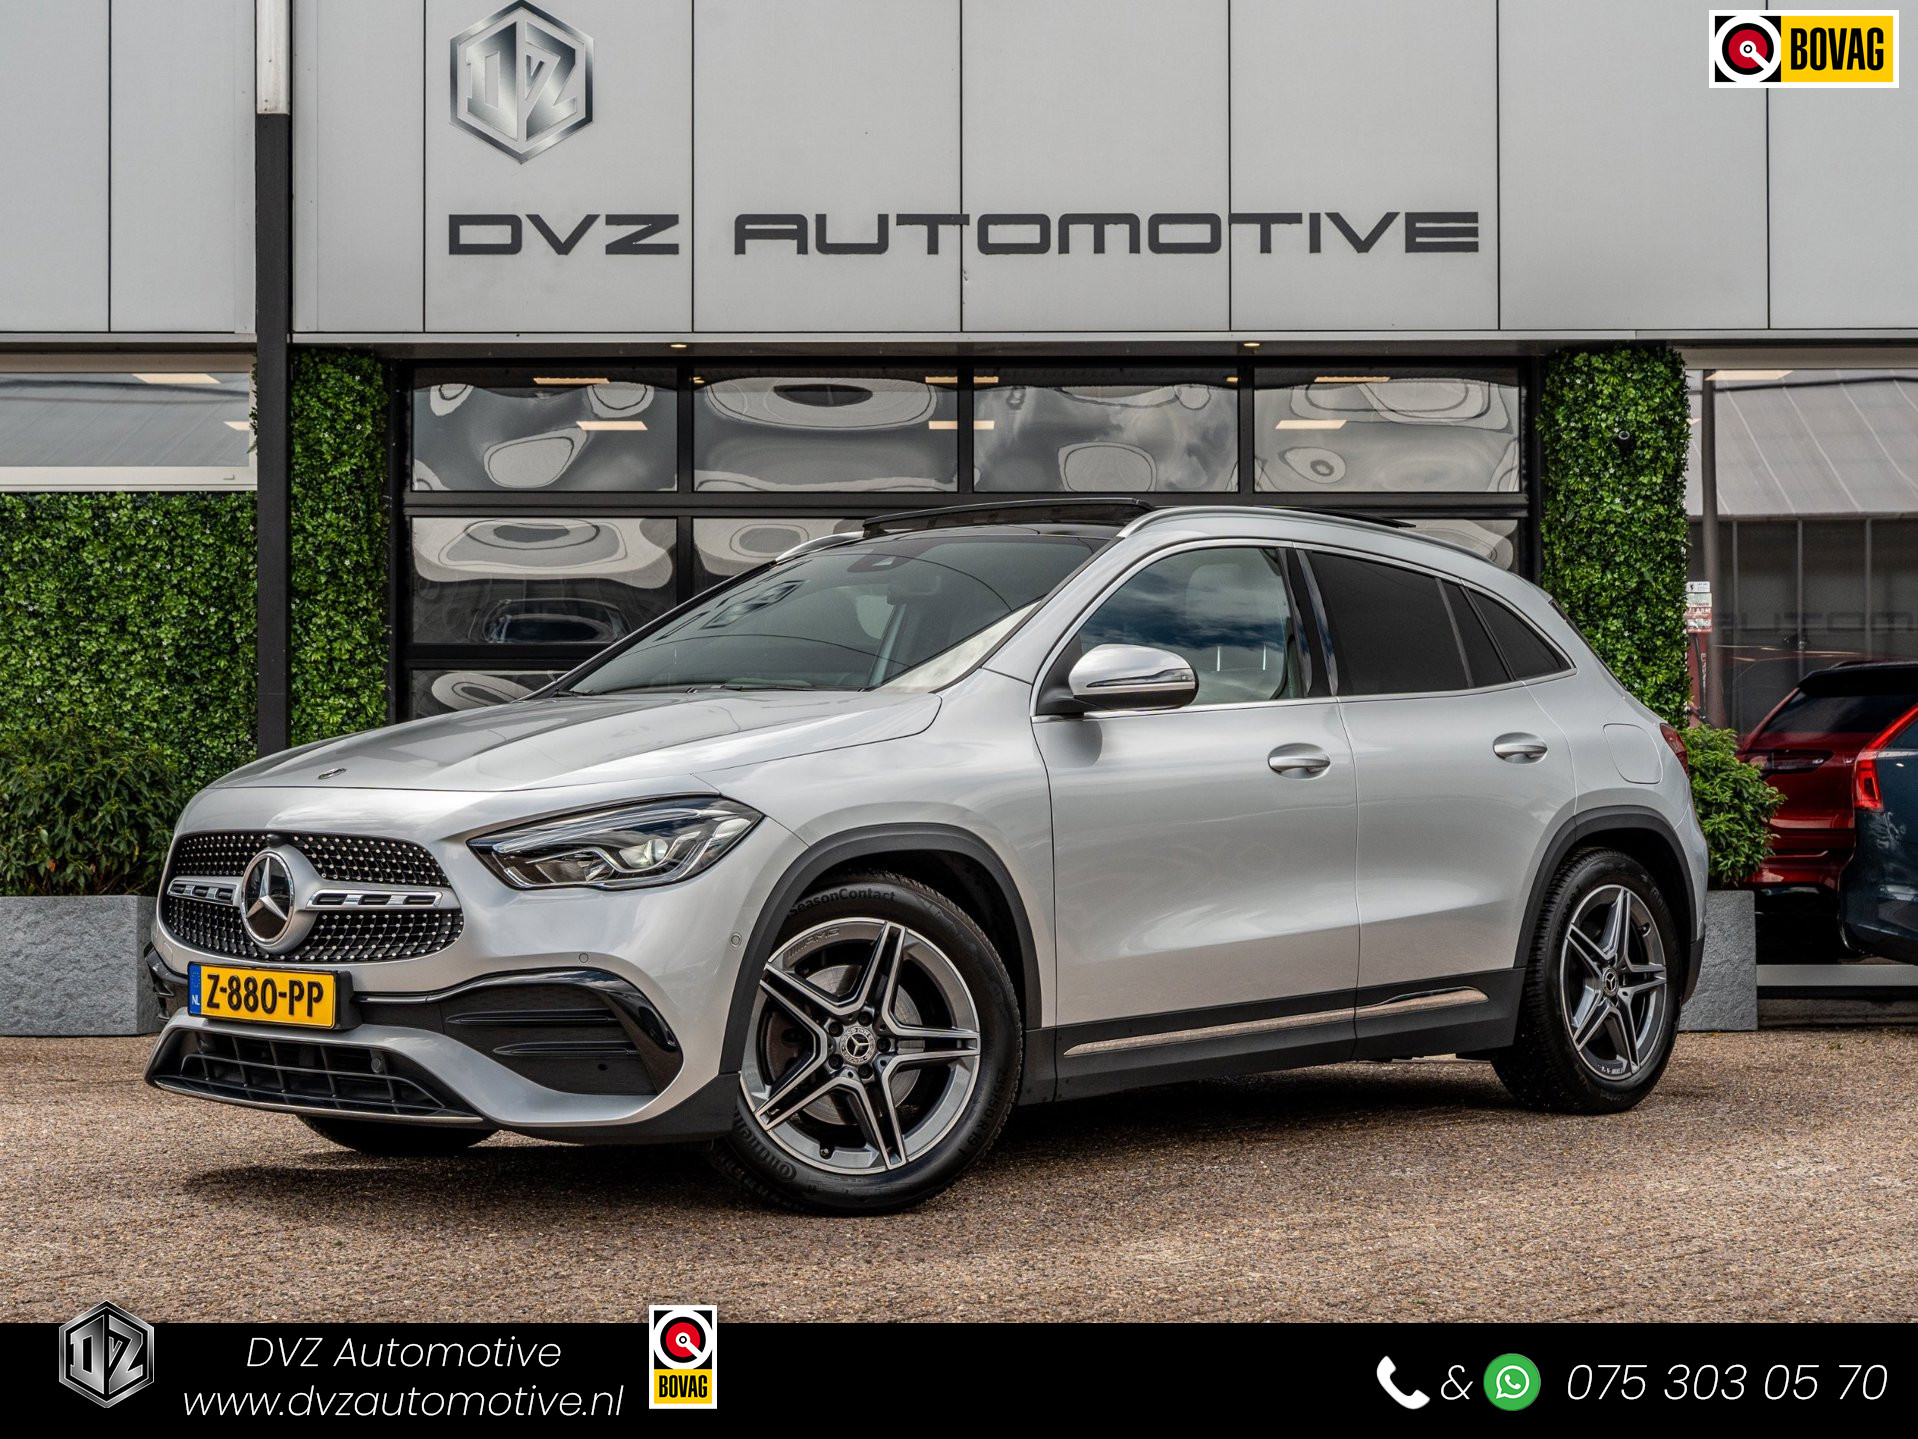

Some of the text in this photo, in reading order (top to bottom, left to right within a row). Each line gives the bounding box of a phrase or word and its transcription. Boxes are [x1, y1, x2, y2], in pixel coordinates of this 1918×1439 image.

[449, 211, 1480, 256] DVZ AUTOMOTIVE
[206, 973, 324, 1018] Z-880-PP
